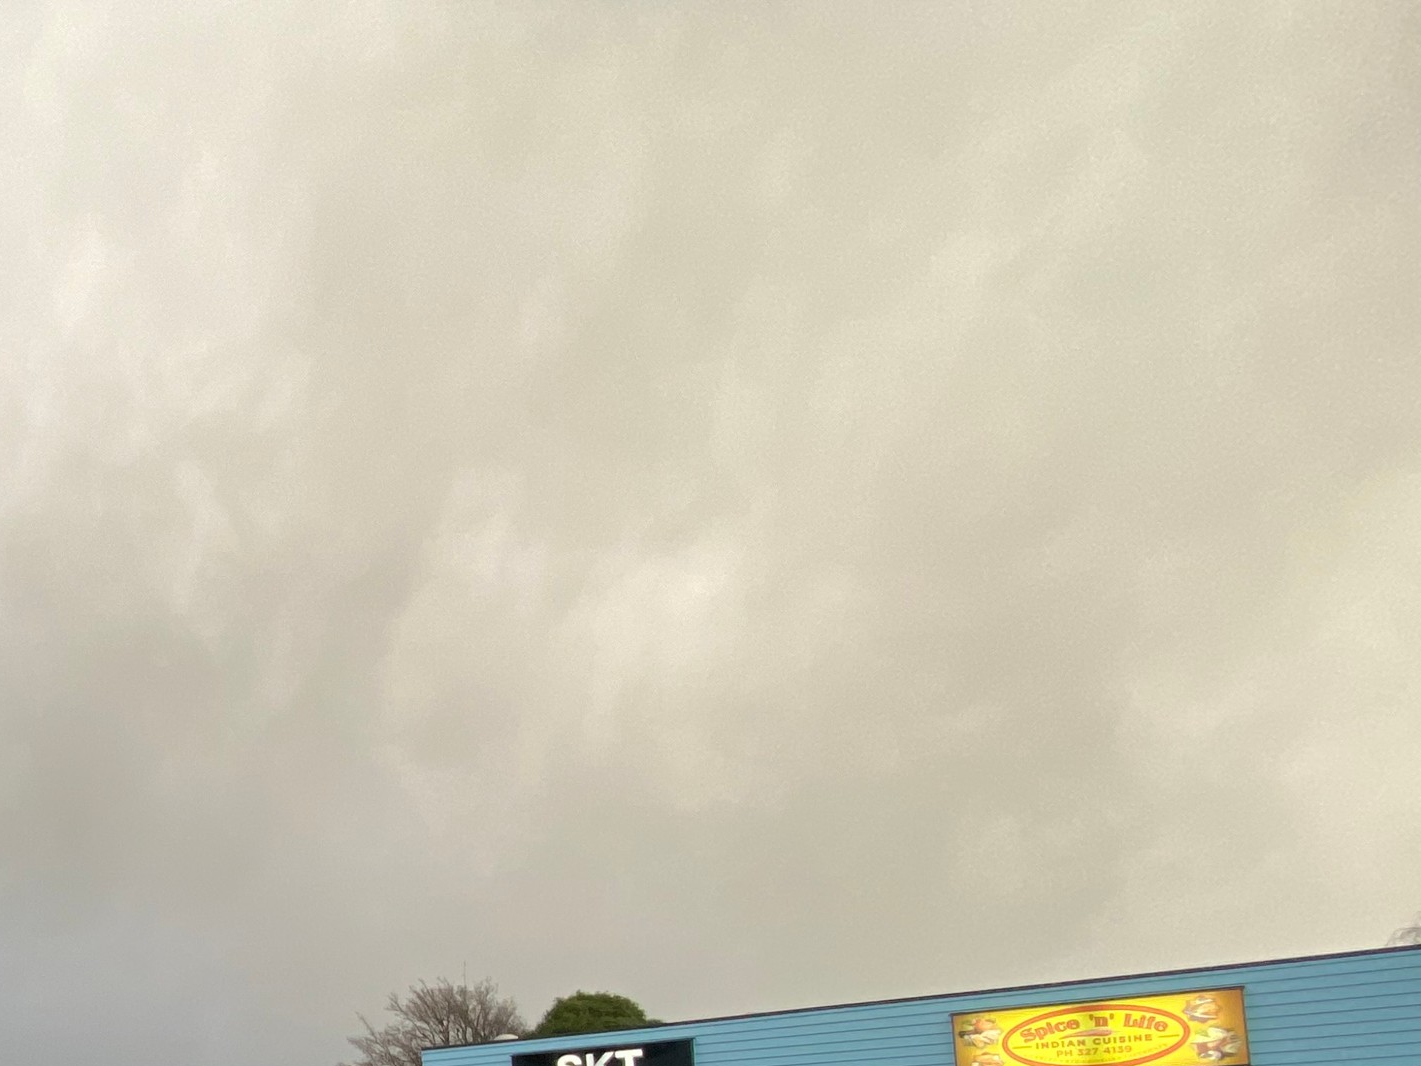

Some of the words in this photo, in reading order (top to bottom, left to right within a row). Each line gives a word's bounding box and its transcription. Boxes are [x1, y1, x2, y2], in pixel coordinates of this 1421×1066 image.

[1019, 1019, 1080, 1043] Spice
[1123, 1013, 1168, 1032] Life
[1035, 1038, 1086, 1050] INDIAN
[1092, 1033, 1153, 1045] CUISINE
[1056, 1050, 1073, 1058] PH
